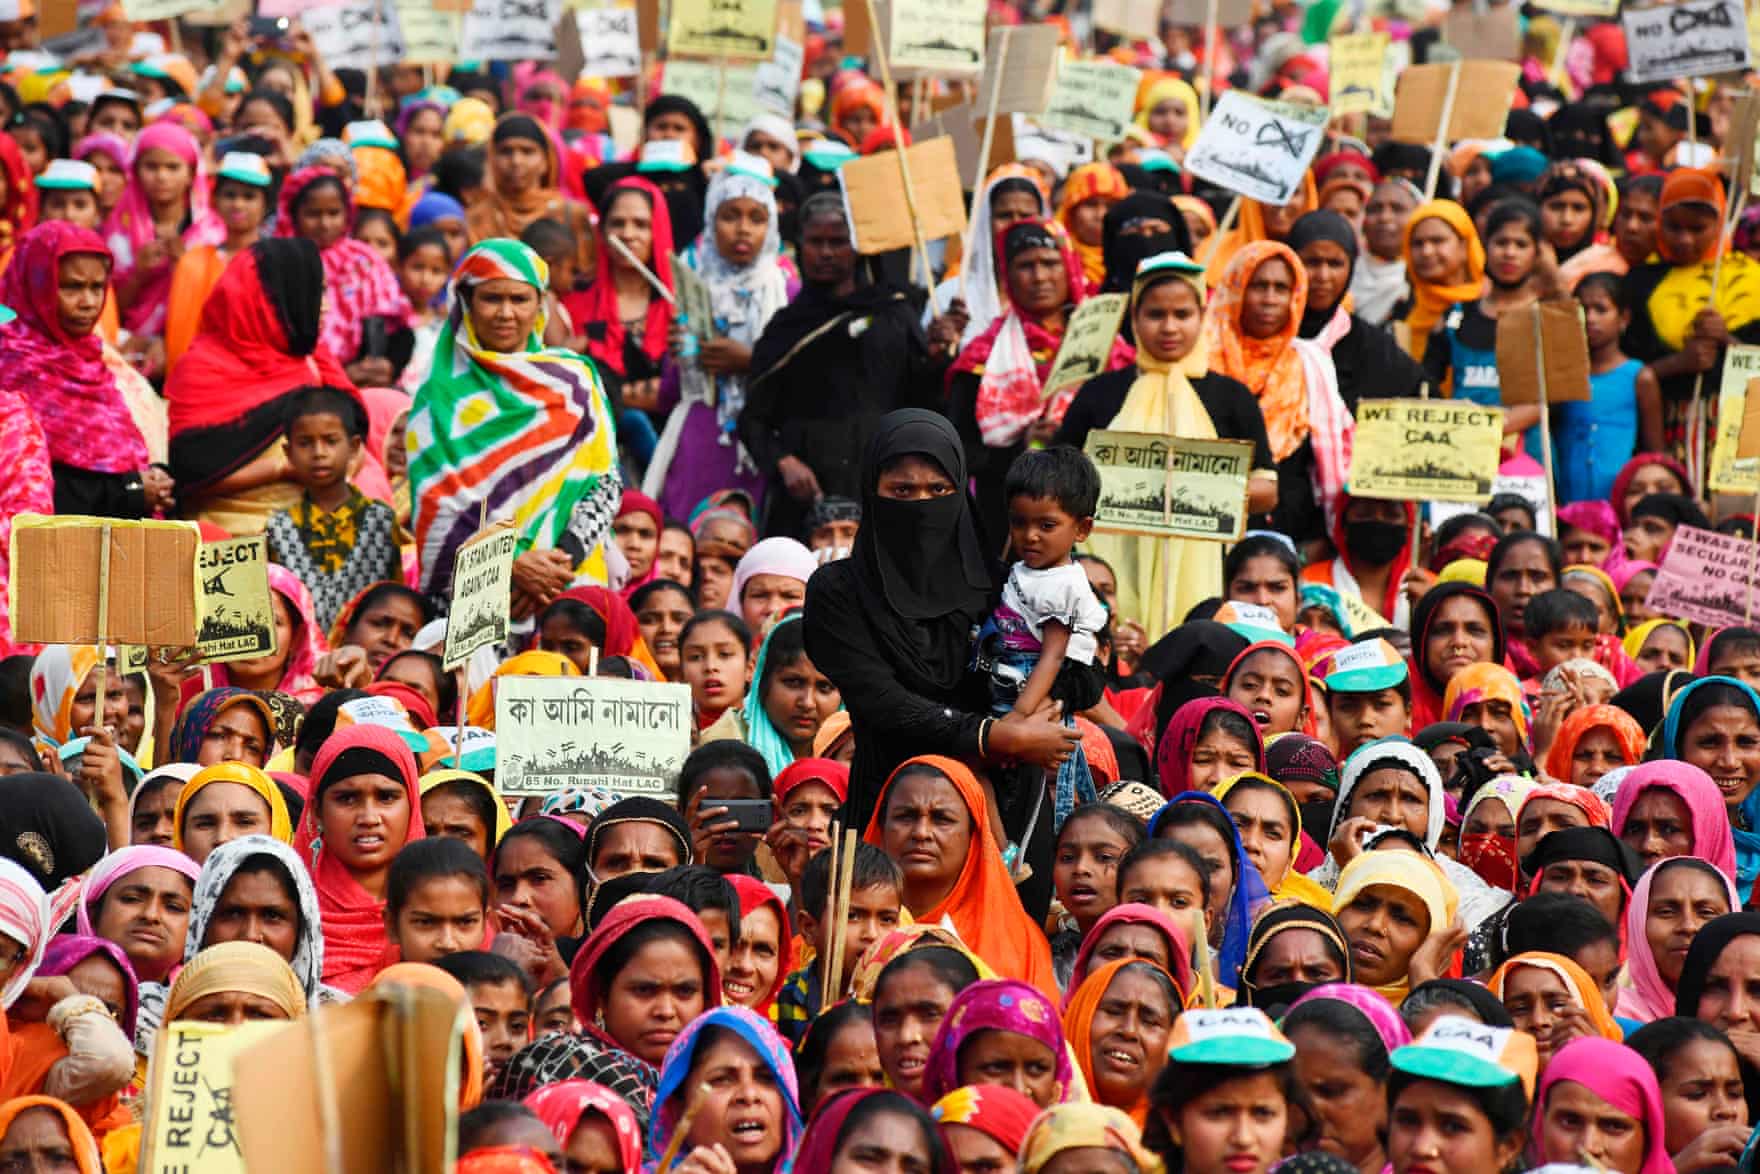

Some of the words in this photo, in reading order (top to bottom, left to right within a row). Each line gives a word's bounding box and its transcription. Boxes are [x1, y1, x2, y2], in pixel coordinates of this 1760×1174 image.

[1222, 113, 1250, 135] NO
[1364, 407, 1396, 421] WE
[1407, 408, 1498, 427] REJECT
[1405, 429, 1451, 446] CAA
[1095, 442, 1119, 466] কা
[1124, 440, 1168, 470] আমি
[1173, 449, 1240, 476] নামানো
[1695, 533, 1731, 550] WAS
[199, 542, 260, 569] EJECT
[1676, 543, 1750, 569] SECULAR
[1702, 565, 1726, 578] NO
[219, 638, 236, 650] Hat
[238, 636, 257, 649] LAC
[507, 697, 536, 728] কা
[542, 687, 595, 728] আমি
[601, 697, 681, 730] নামানো
[525, 776, 540, 786] 85
[544, 776, 564, 786] No.
[613, 777, 632, 788] Hat
[636, 778, 662, 790] LAC
[165, 1031, 203, 1148] REJECT
